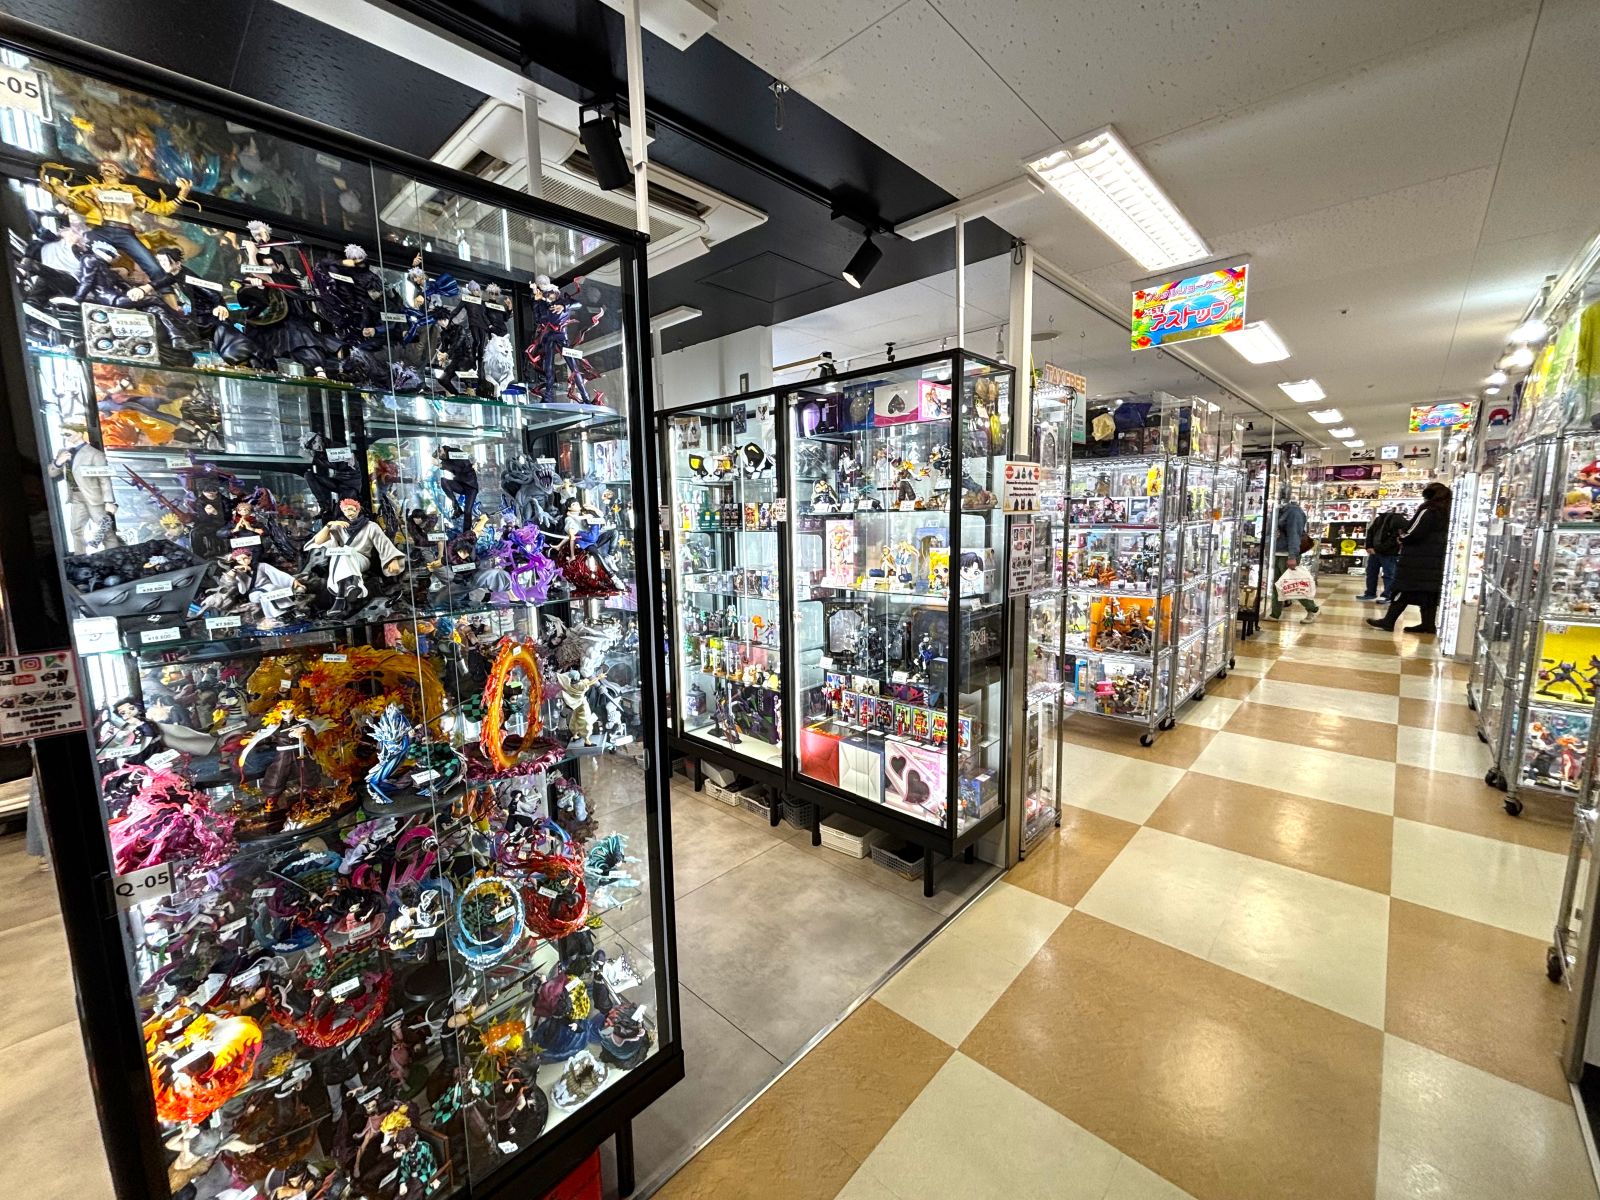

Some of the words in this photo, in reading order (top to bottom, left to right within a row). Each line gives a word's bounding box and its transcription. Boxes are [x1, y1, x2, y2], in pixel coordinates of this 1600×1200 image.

[1150, 295, 1235, 332] アストップ
[1046, 364, 1065, 385] TAX
[1064, 371, 1086, 394] FREE
[115, 871, 169, 897] Q-05
